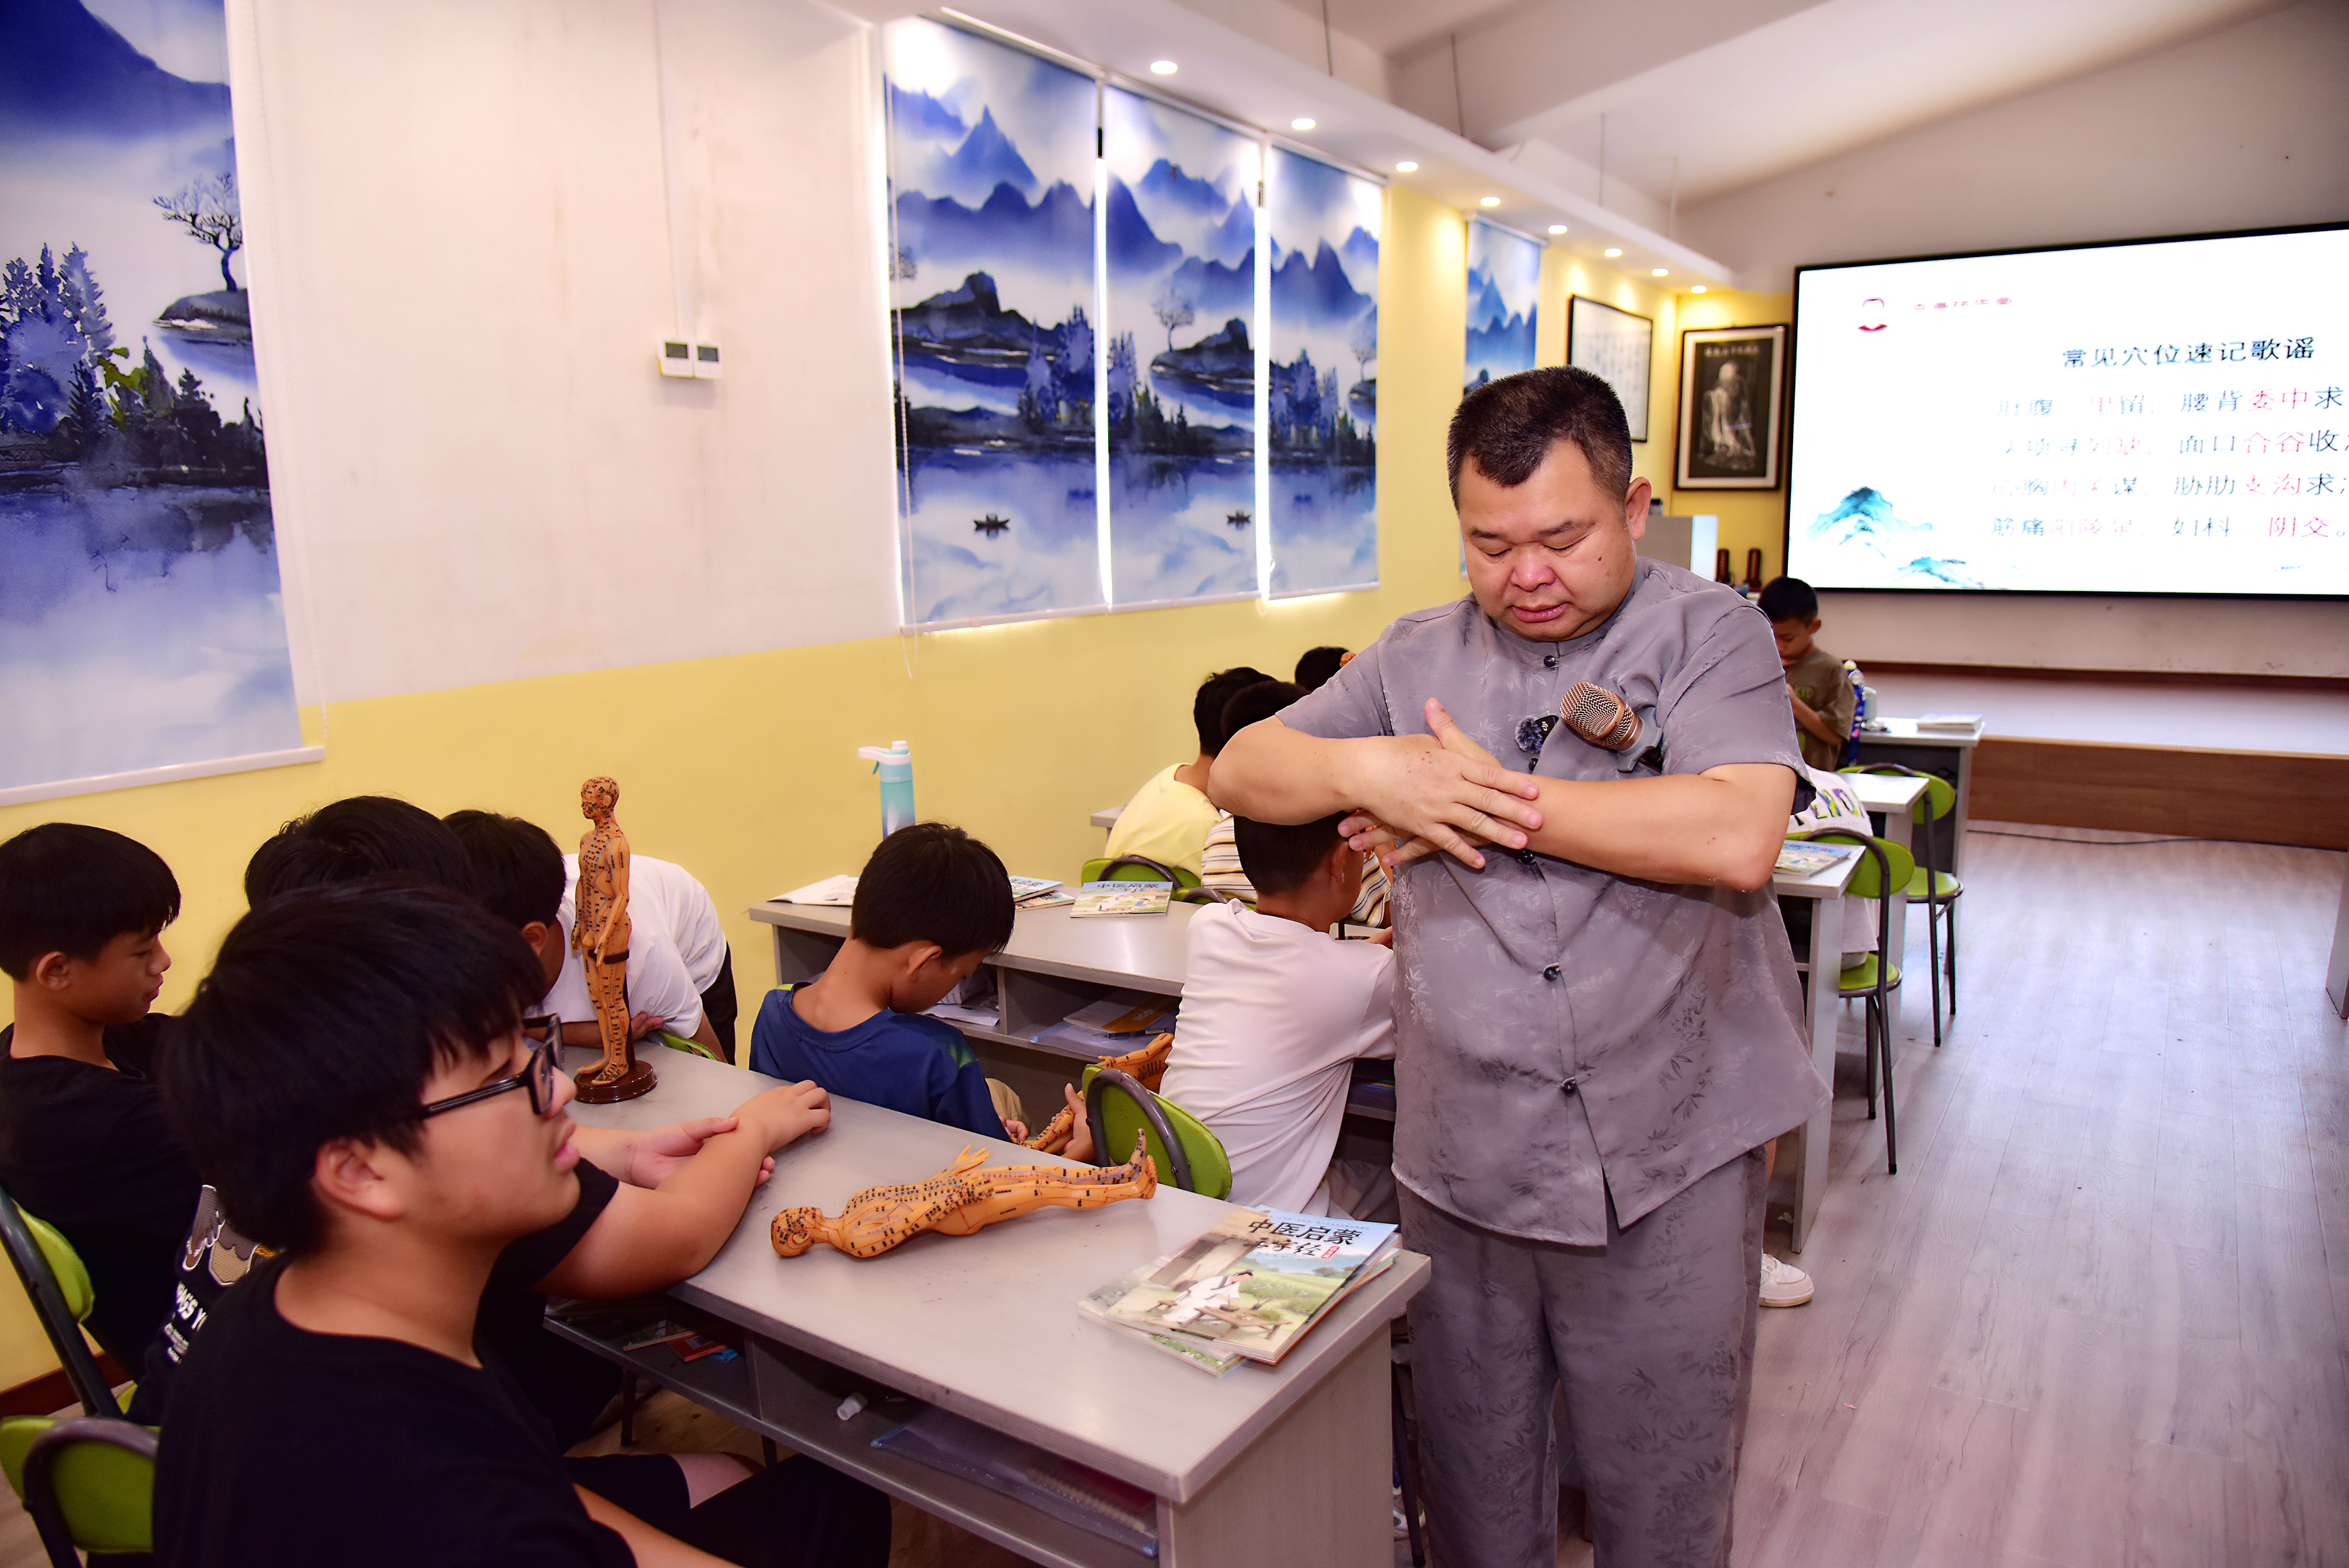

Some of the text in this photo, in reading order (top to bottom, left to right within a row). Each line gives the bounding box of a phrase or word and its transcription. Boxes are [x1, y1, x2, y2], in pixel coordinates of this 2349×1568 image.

[2063, 336, 2315, 368] 常见穴位速记歌谣
[1248, 1218, 1363, 1245] 中医启蒙
